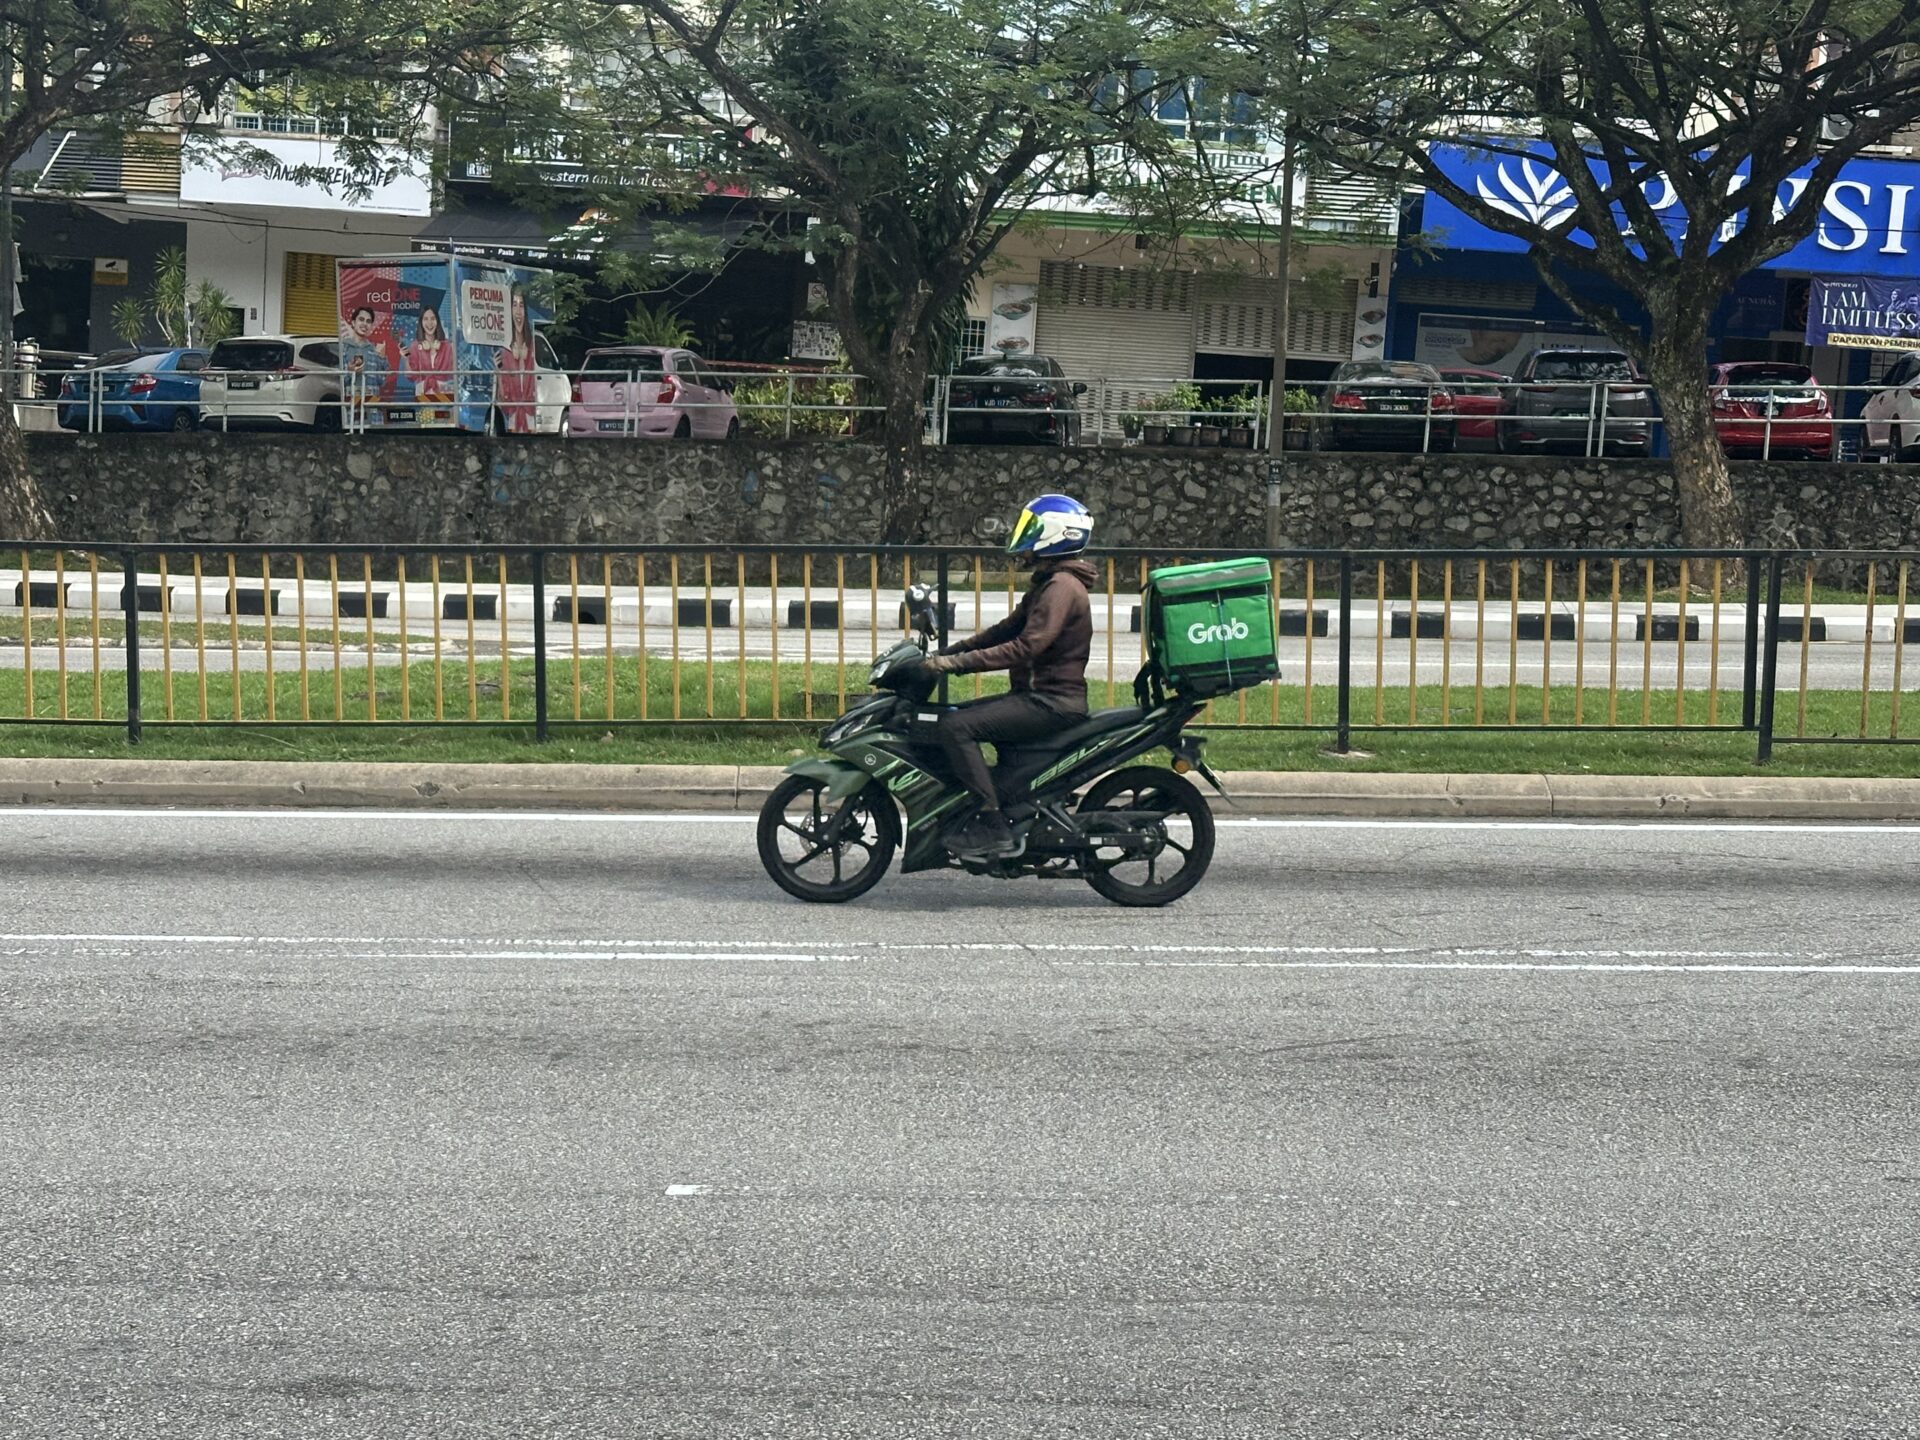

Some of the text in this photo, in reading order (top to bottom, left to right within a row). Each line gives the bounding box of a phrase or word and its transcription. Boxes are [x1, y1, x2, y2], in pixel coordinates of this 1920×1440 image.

[1620, 165, 1915, 255] PSI
[450, 245, 485, 254] andwiches
[498, 248, 514, 257] Pasta
[528, 250, 548, 259] Burger
[469, 286, 504, 303] PERCUMA
[1823, 289, 1867, 308] I AM
[391, 301, 421, 310] mobile
[470, 312, 505, 331] redONE
[1822, 307, 1917, 330] LIMITLESS
[1832, 335, 1883, 346] DAPATKAN
[1187, 617, 1249, 645] Grab
